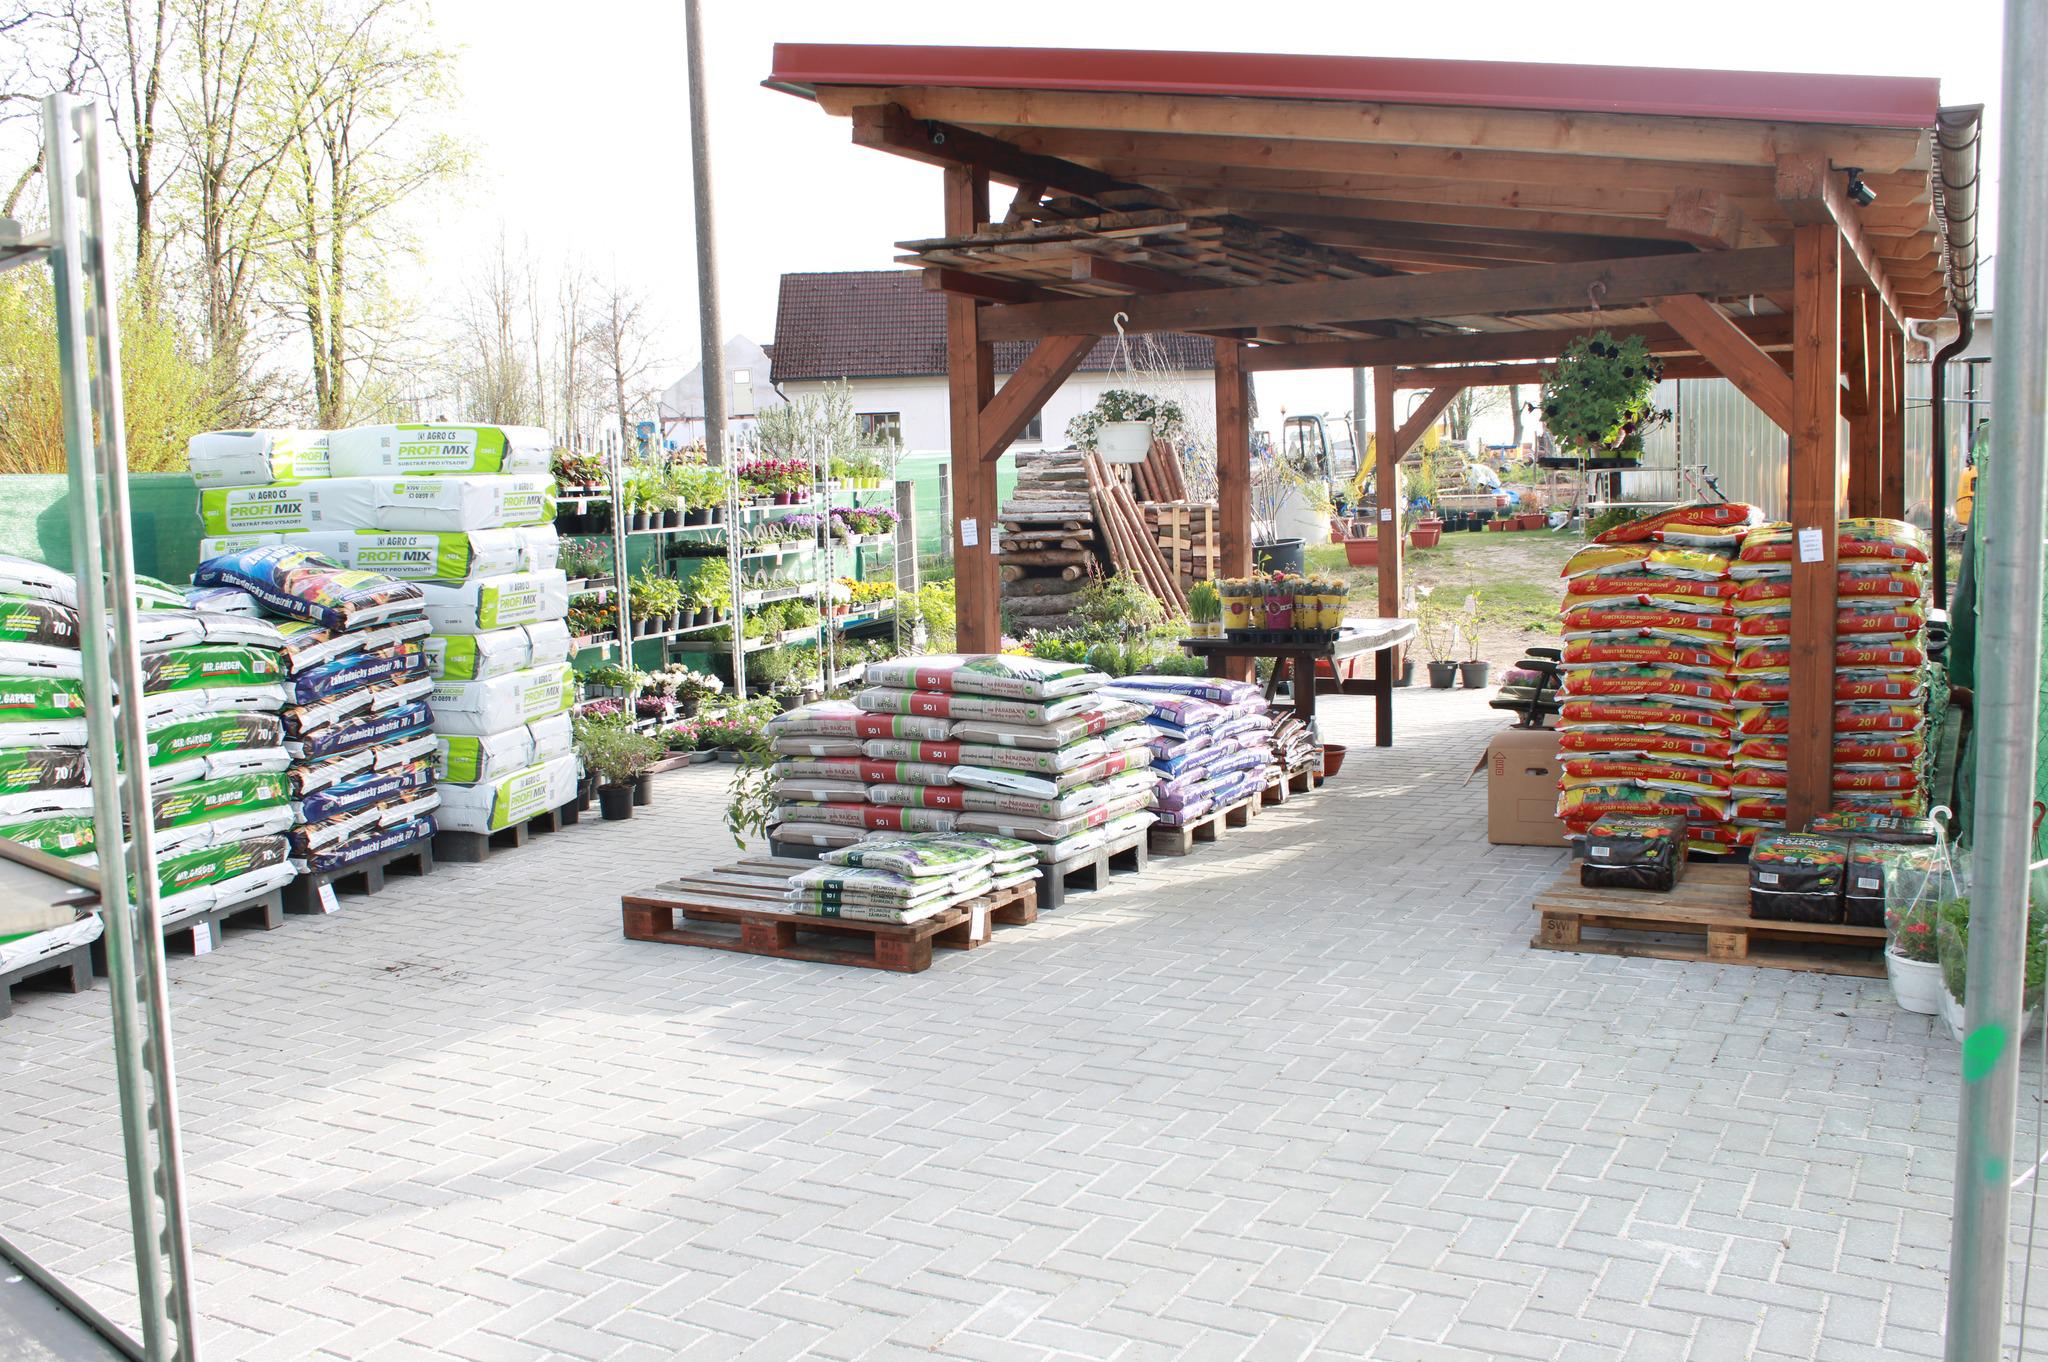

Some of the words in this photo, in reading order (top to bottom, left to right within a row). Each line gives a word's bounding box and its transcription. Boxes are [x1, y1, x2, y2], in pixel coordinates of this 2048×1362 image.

[426, 432, 446, 440] AGRO
[447, 432, 456, 440] CS
[398, 445, 440, 456] PROFI
[442, 444, 470, 455] MIX
[258, 490, 278, 499] AGRO
[279, 490, 287, 498] CS
[503, 496, 526, 507] PROFI
[526, 495, 543, 505] MIX
[230, 505, 273, 517] PROFI
[274, 503, 302, 514] MIX
[1688, 512, 1699, 520] 20
[386, 537, 407, 546] AGRO
[408, 536, 418, 545] CS
[1860, 546, 1872, 554] 20
[357, 552, 402, 561] PROFI
[403, 551, 431, 561] MIX
[1674, 585, 1688, 593] 20
[1857, 582, 1870, 591] 20
[293, 600, 304, 612] 70
[500, 598, 522, 609] PROFI
[522, 594, 537, 606] MIX
[1667, 617, 1680, 625] 20
[1862, 619, 1875, 628] 20
[52, 621, 66, 635] 70
[1667, 652, 1679, 660] 20
[1857, 652, 1870, 661] 20
[393, 658, 400, 670] 70
[1668, 684, 1680, 692] 20
[1854, 685, 1867, 694] 20
[524, 690, 546, 704] PROFI
[546, 686, 560, 697] MIX
[1669, 713, 1681, 722] 20
[400, 717, 408, 728] 70
[1858, 718, 1871, 727] 20
[258, 728, 268, 740] 70
[1662, 741, 1674, 749] 20
[1862, 749, 1876, 757] 20
[54, 766, 68, 780] 70
[1669, 771, 1681, 779] 20
[401, 777, 410, 787] 70
[1853, 777, 1866, 786] 20
[510, 789, 533, 806] PROFI
[533, 784, 546, 798] MIX
[876, 818, 885, 826] 50
